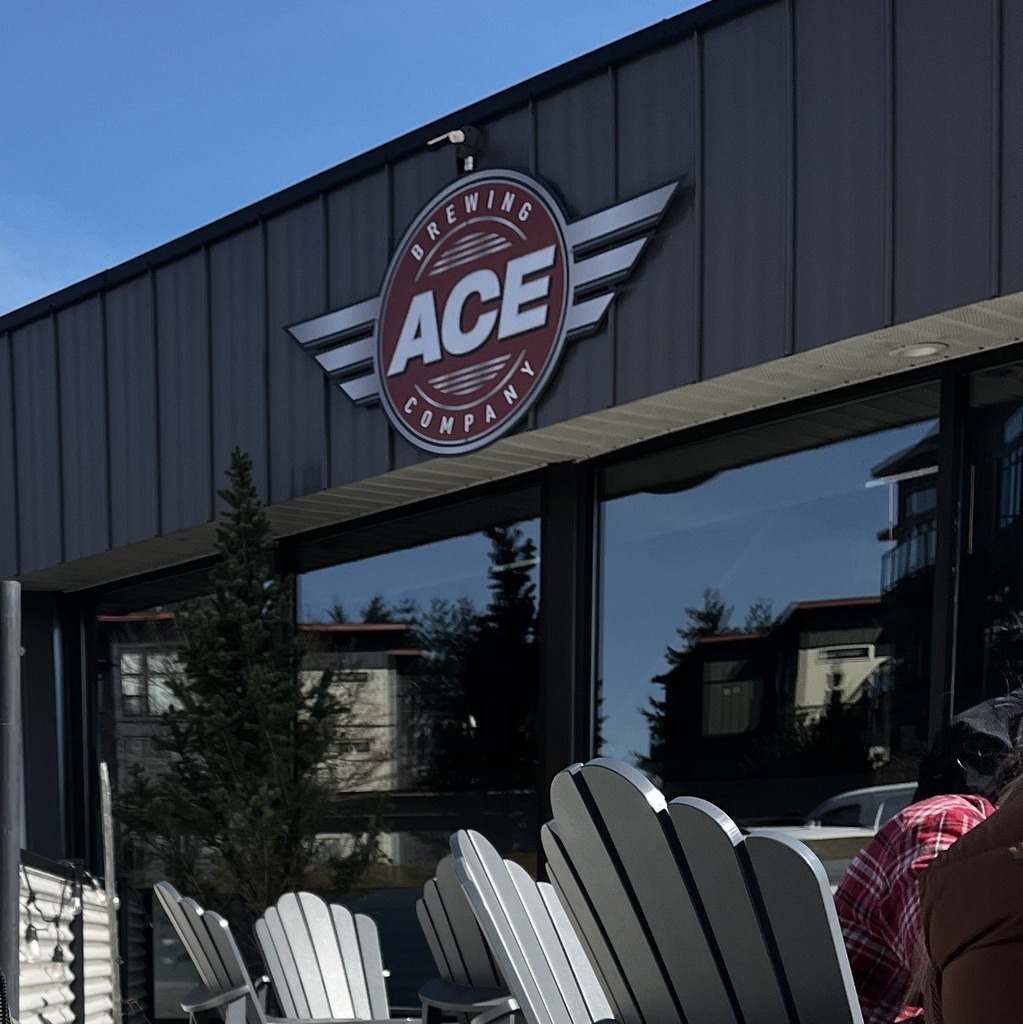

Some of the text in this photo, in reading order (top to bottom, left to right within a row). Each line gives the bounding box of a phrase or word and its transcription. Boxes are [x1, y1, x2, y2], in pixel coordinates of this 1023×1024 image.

[411, 190, 532, 261] BREWING
[386, 245, 556, 377] ACE
[404, 360, 535, 435] COMPANY
